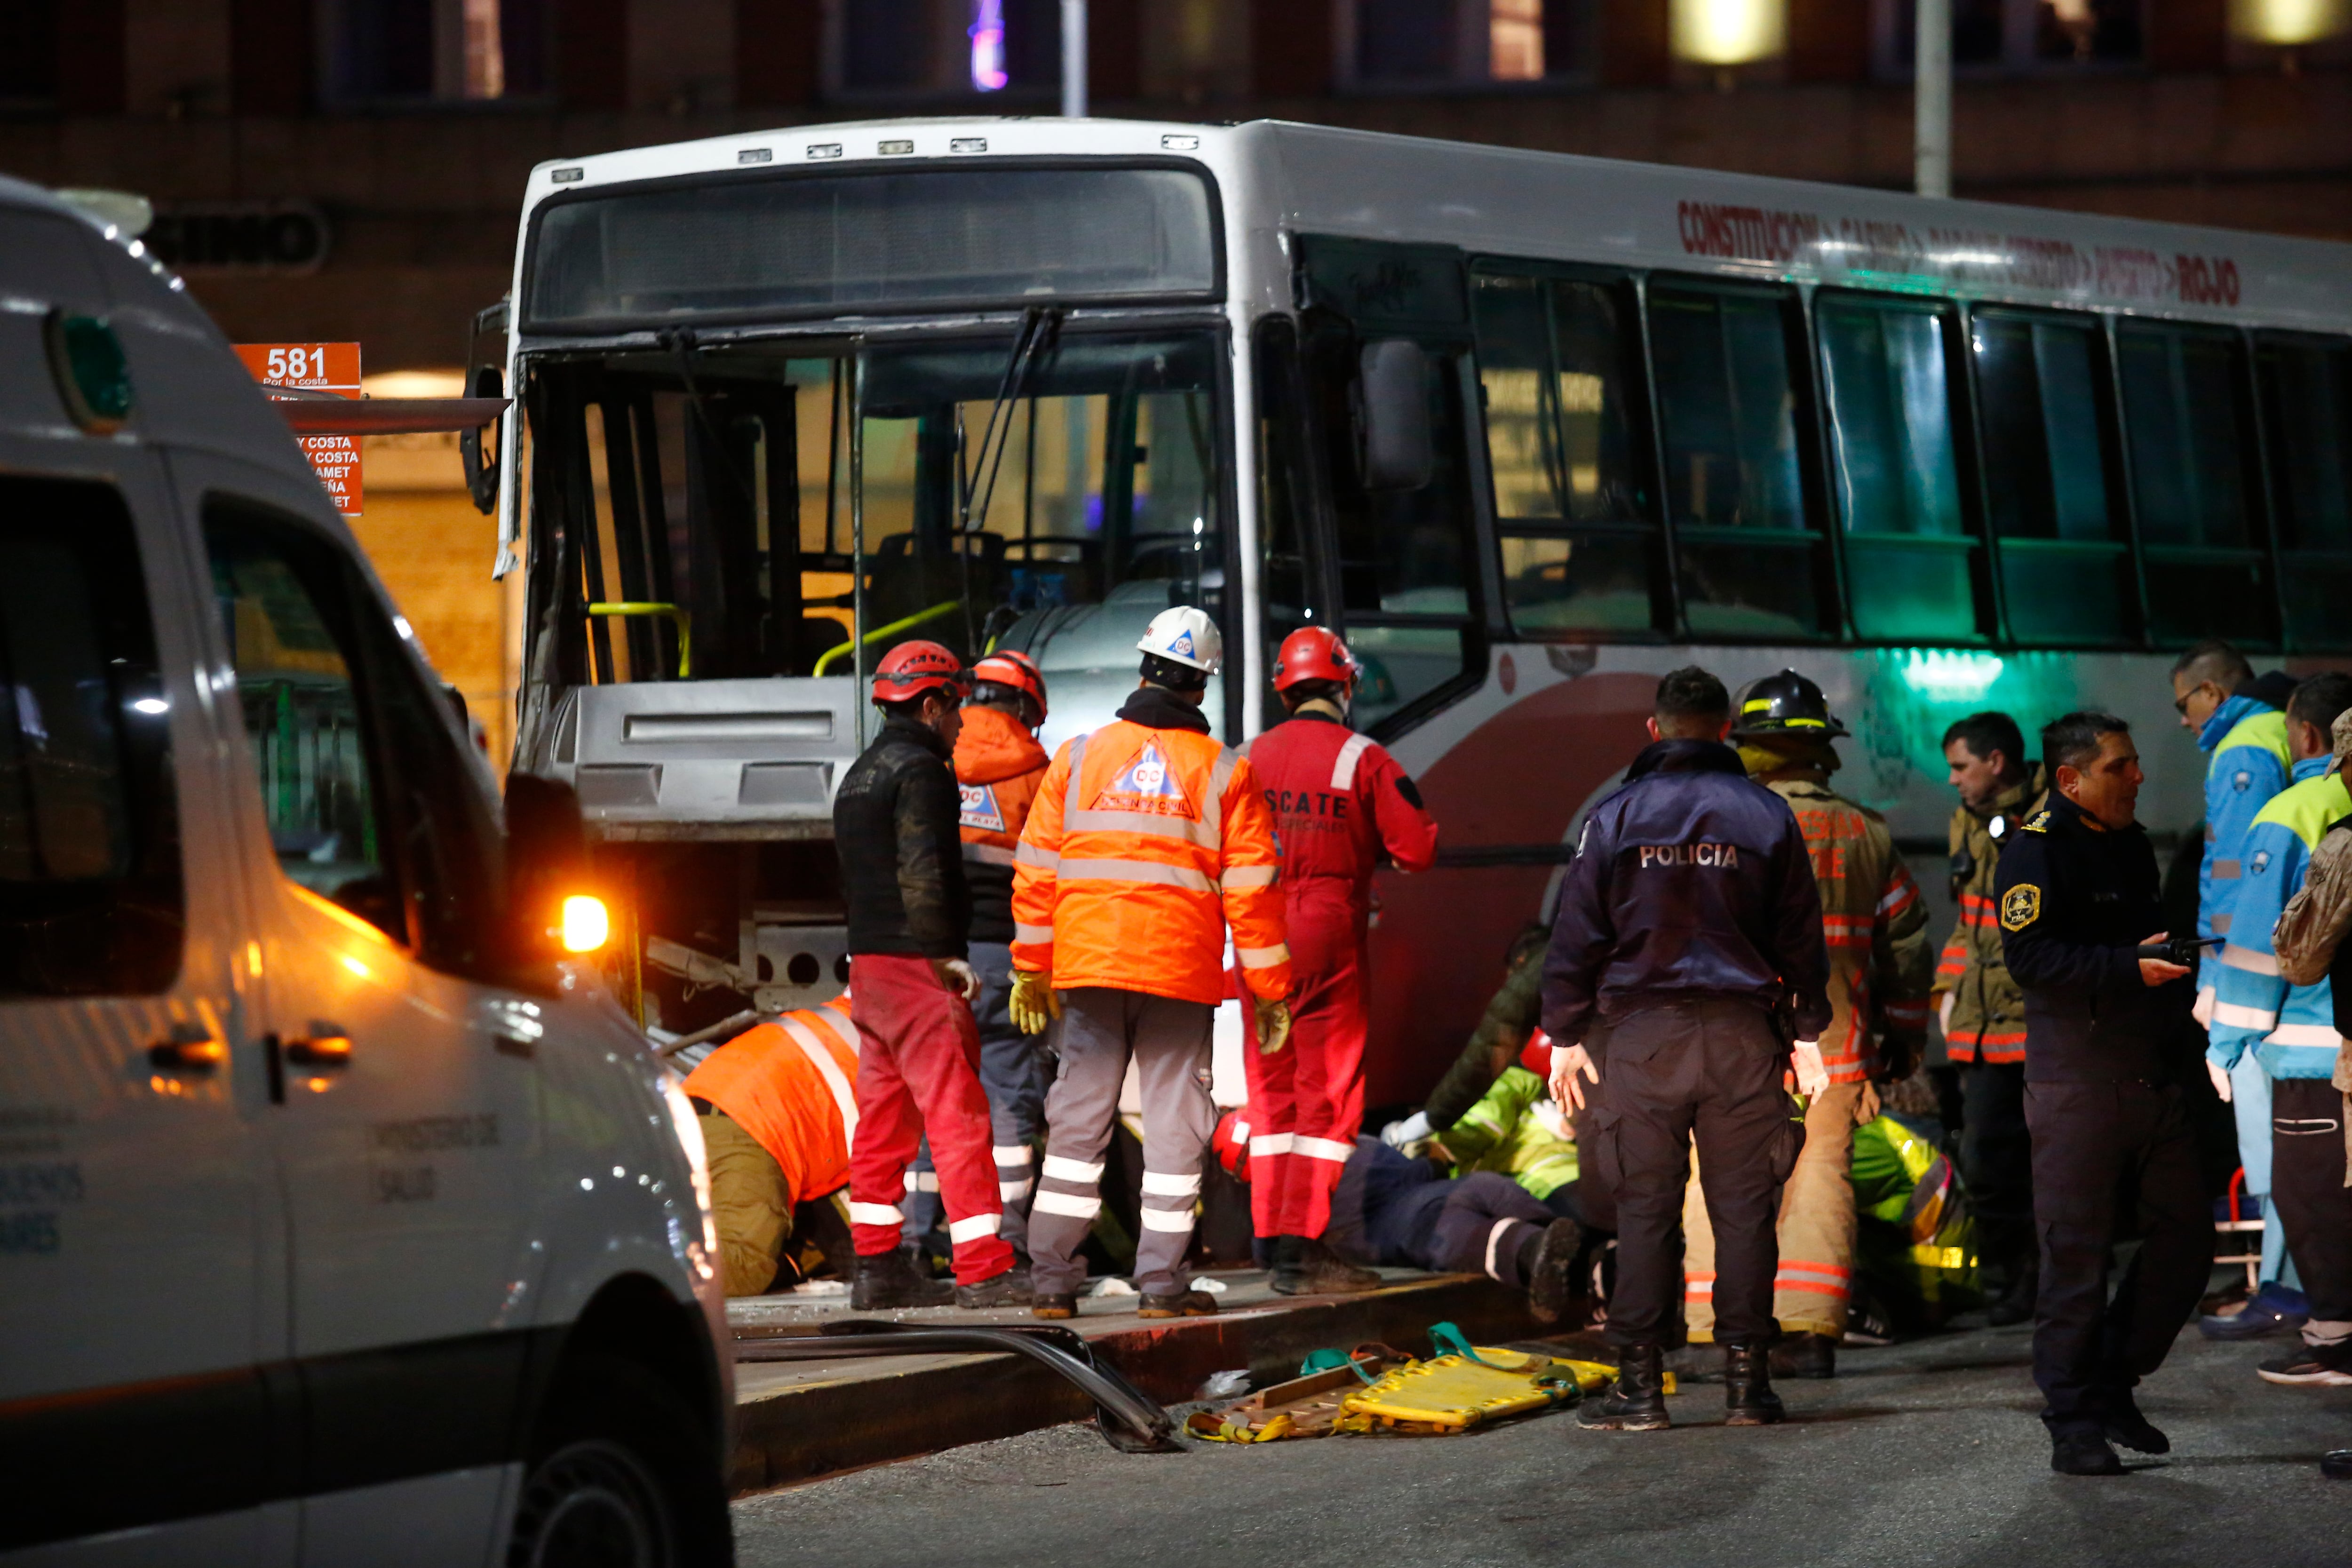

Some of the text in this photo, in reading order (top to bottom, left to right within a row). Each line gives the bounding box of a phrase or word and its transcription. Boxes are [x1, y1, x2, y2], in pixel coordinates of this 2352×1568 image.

[2177, 253, 2241, 307] ROJO
[268, 347, 325, 379] 581
[263, 377, 328, 386] Por la costa
[308, 437, 352, 449] COSTA
[315, 451, 359, 463] COSTA
[315, 466, 351, 478] AMET
[332, 495, 351, 508] ET
[1177, 641, 1191, 652] DC
[1136, 769, 1160, 783] DC
[960, 790, 981, 803] DC
[1158, 800, 1188, 813] CIVIL
[1264, 789, 1349, 819] SCATE
[1640, 843, 1740, 870] POLICIA
